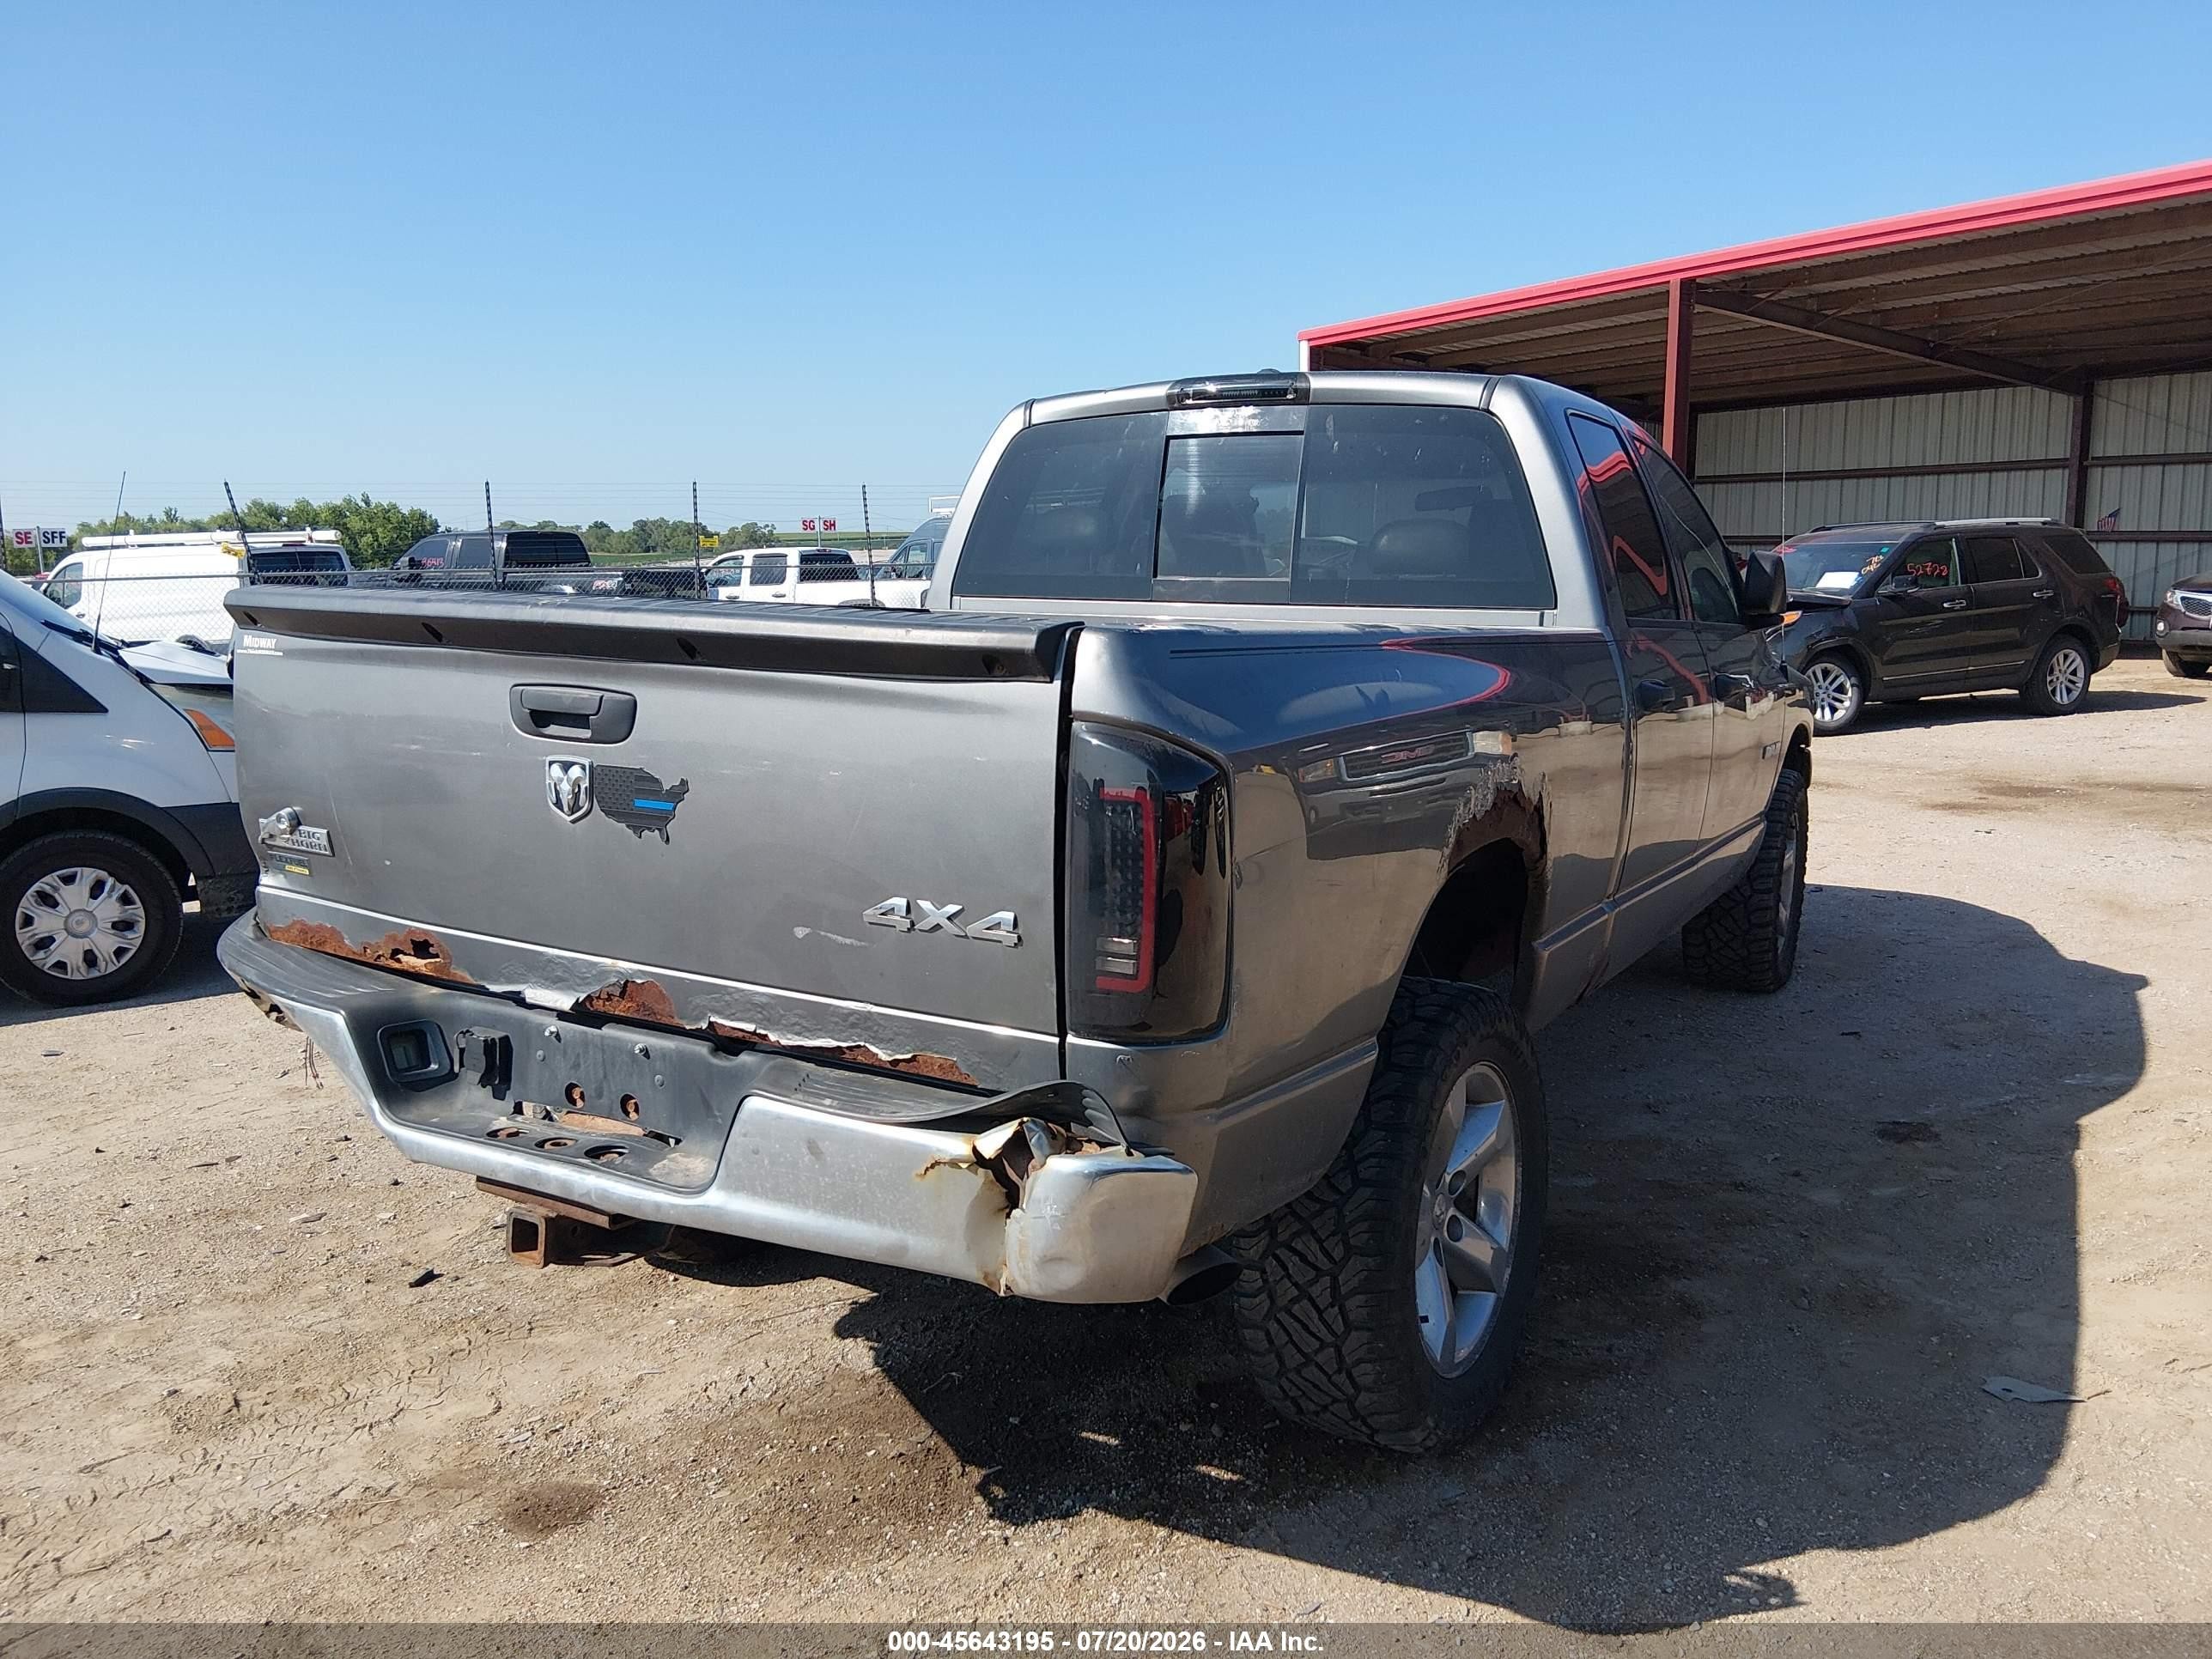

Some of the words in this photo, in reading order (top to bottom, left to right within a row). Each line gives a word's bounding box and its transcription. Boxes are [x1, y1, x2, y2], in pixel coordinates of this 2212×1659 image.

[802, 520, 816, 531] SG
[823, 520, 836, 531] SH
[15, 531, 33, 545] SE
[42, 531, 66, 544] SFF
[298, 829, 321, 841] BIG
[291, 837, 329, 853] HORN
